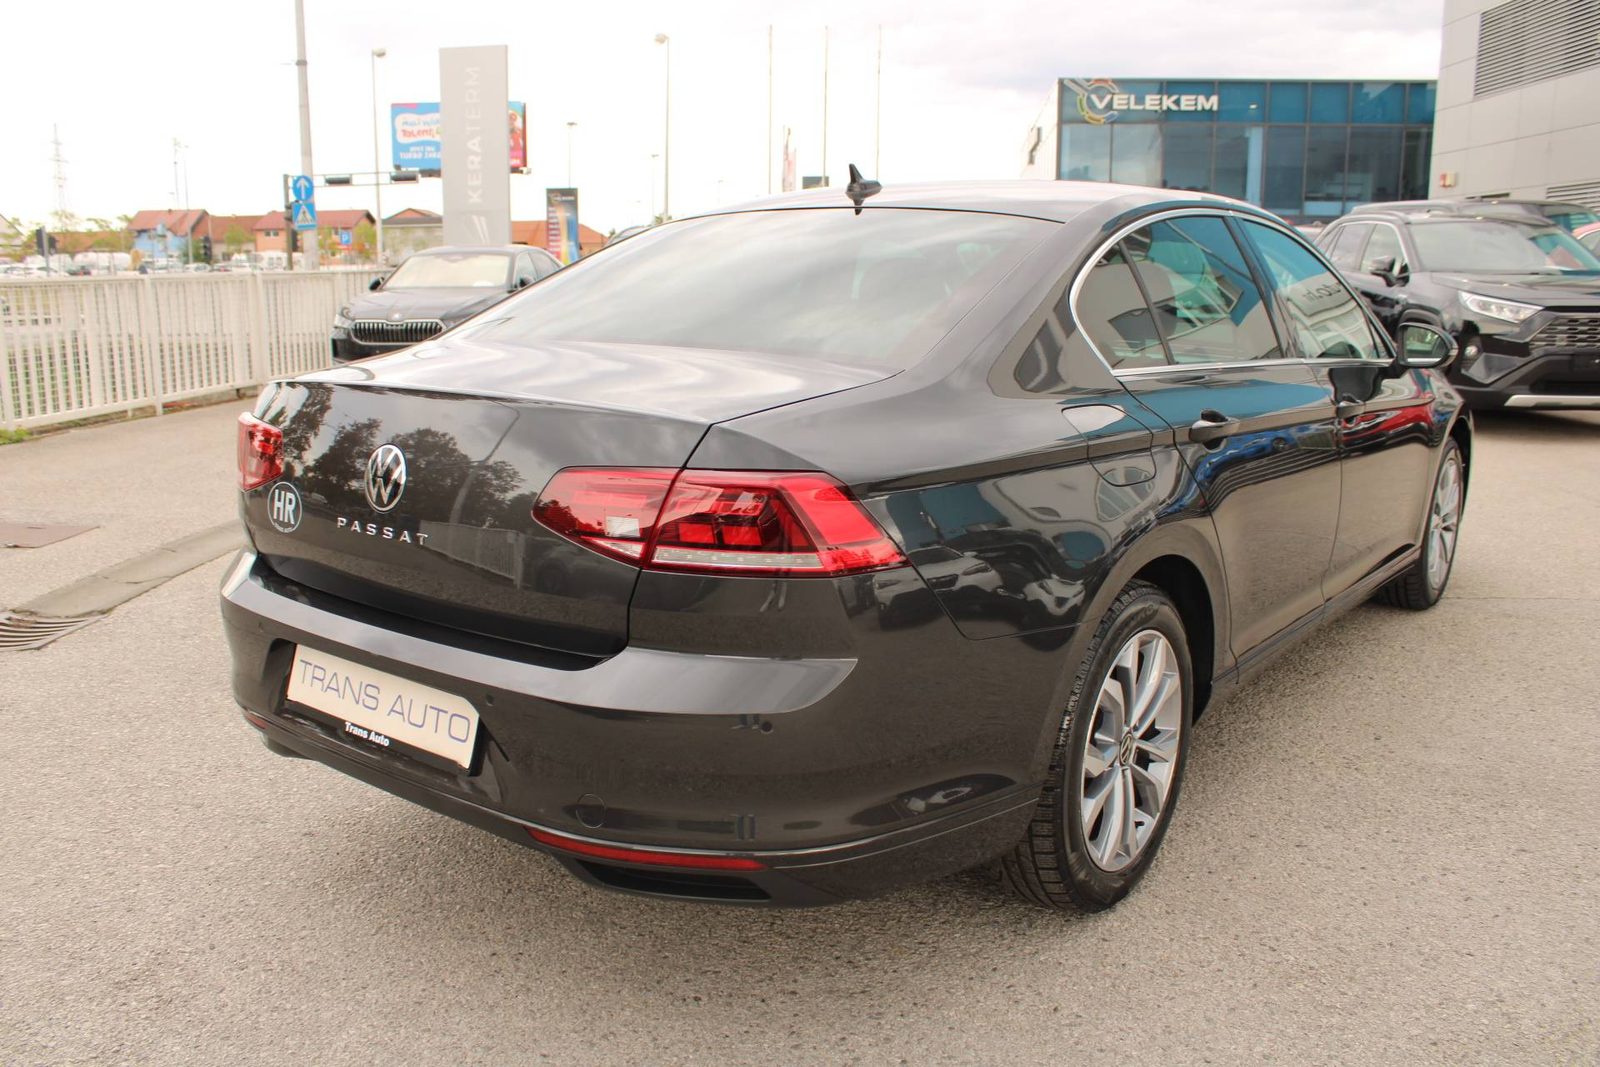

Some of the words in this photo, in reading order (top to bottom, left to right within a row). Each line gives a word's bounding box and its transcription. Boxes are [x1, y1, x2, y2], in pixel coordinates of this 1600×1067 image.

[1090, 94, 1219, 111] VELEKEM
[464, 66, 483, 205] KERATERM
[273, 489, 295, 525] HR
[336, 517, 429, 546] PASSAT
[299, 659, 381, 712] TRANS
[387, 694, 471, 744] AUTO
[344, 721, 369, 740] Trans
[368, 730, 390, 747] Auto
